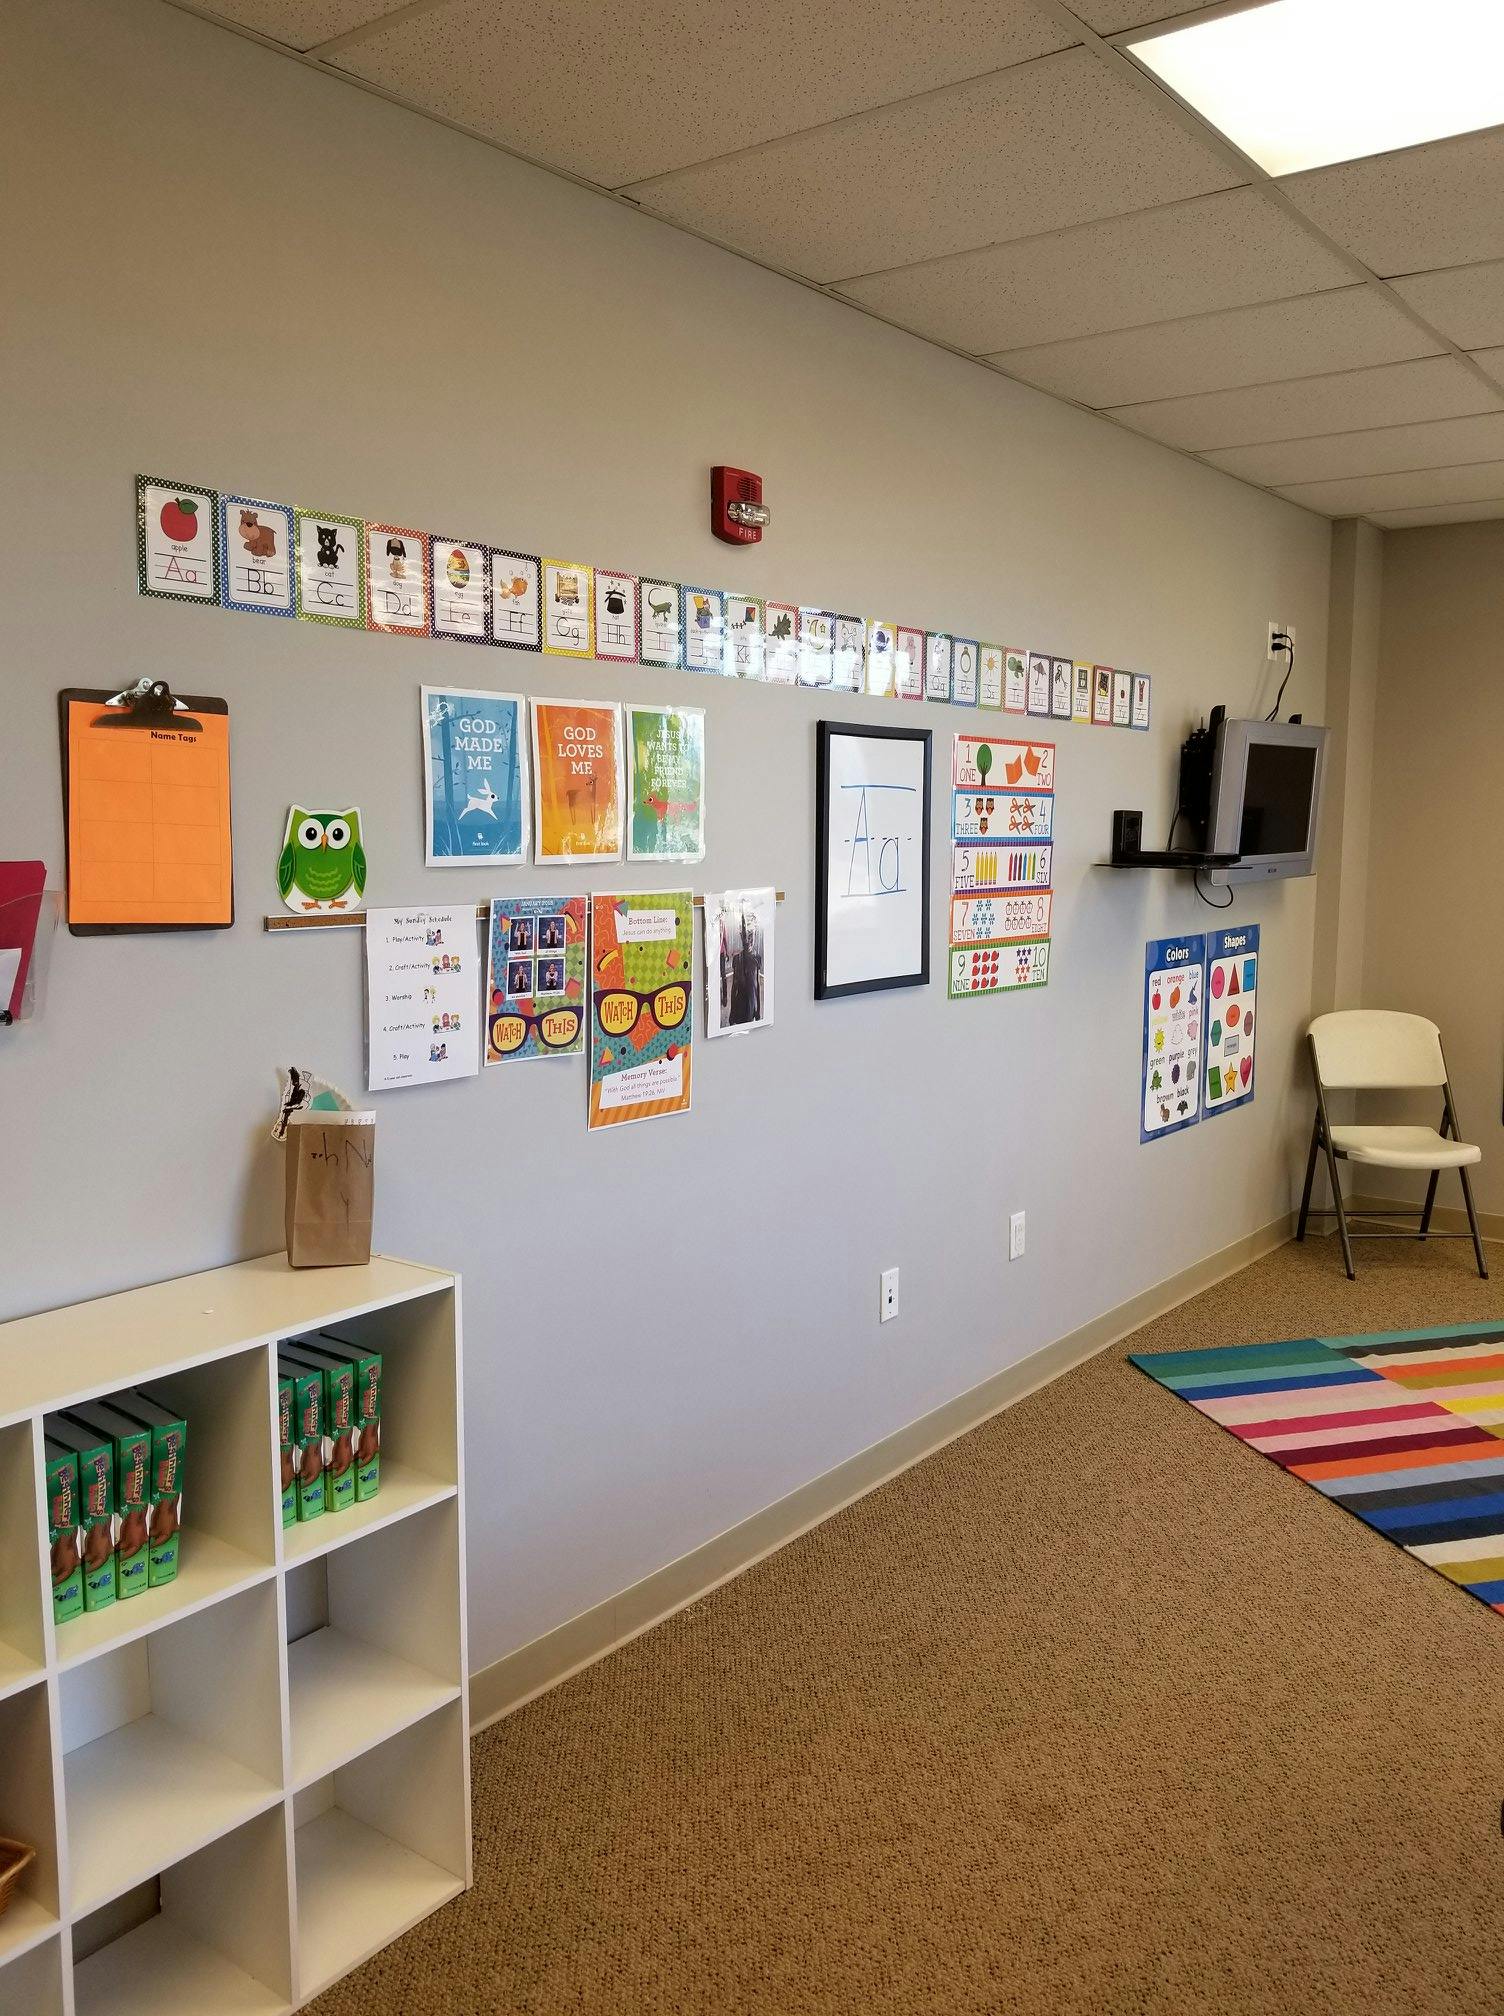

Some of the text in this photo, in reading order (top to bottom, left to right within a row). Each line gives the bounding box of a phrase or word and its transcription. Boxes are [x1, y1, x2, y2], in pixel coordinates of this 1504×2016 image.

[739, 528, 756, 540] FIRE
[171, 543, 188, 552] apple
[252, 556, 266, 565] bear
[165, 557, 197, 583] Aa
[247, 569, 274, 595] Bb
[316, 582, 344, 607] Cc
[386, 591, 412, 616] Dd
[510, 611, 526, 633] Ff
[556, 616, 580, 646] Gg
[607, 624, 626, 644] Hh
[460, 718, 496, 734] GOD
[564, 726, 596, 741] GOD
[150, 730, 197, 743] Name Tags
[454, 736, 503, 754] MADE
[558, 743, 604, 759] LOVES
[965, 744, 972, 764] 1
[1040, 750, 1048, 768] 2
[468, 755, 492, 771] ME
[570, 760, 592, 775] ME
[960, 768, 976, 782] ONE
[1036, 772, 1051, 786] TWO
[964, 798, 972, 818] 3
[1040, 803, 1046, 822] 4
[956, 822, 978, 835] THREE
[1034, 824, 1049, 836] FOUR
[961, 850, 970, 872] 5
[1040, 848, 1046, 869] 6
[955, 874, 975, 890] FIVE
[1036, 871, 1048, 884] SIX
[961, 902, 970, 927] 7
[1036, 896, 1044, 922] 8
[628, 917, 652, 925] Bottom
[1032, 922, 1048, 934] EIGHT
[392, 936, 425, 944] Play/Activity
[953, 928, 976, 941] SEVEN
[1224, 934, 1246, 949] Shapes
[1032, 946, 1046, 968] 10
[1166, 947, 1190, 962] Colors
[958, 954, 966, 976] 9
[1032, 969, 1046, 982] TEN
[1152, 976, 1161, 986] red
[1166, 974, 1184, 985] orange
[952, 978, 970, 992] NINE
[392, 994, 412, 1002] Worship
[658, 994, 684, 1017] THIS
[604, 1001, 633, 1024] WATCH
[496, 1022, 523, 1043] WATCH
[545, 1018, 575, 1038] THIS
[1150, 1056, 1165, 1070] green
[1169, 1050, 1184, 1064] purple
[621, 1068, 668, 1081] Memory Verse:
[1156, 1086, 1189, 1103] brown black
